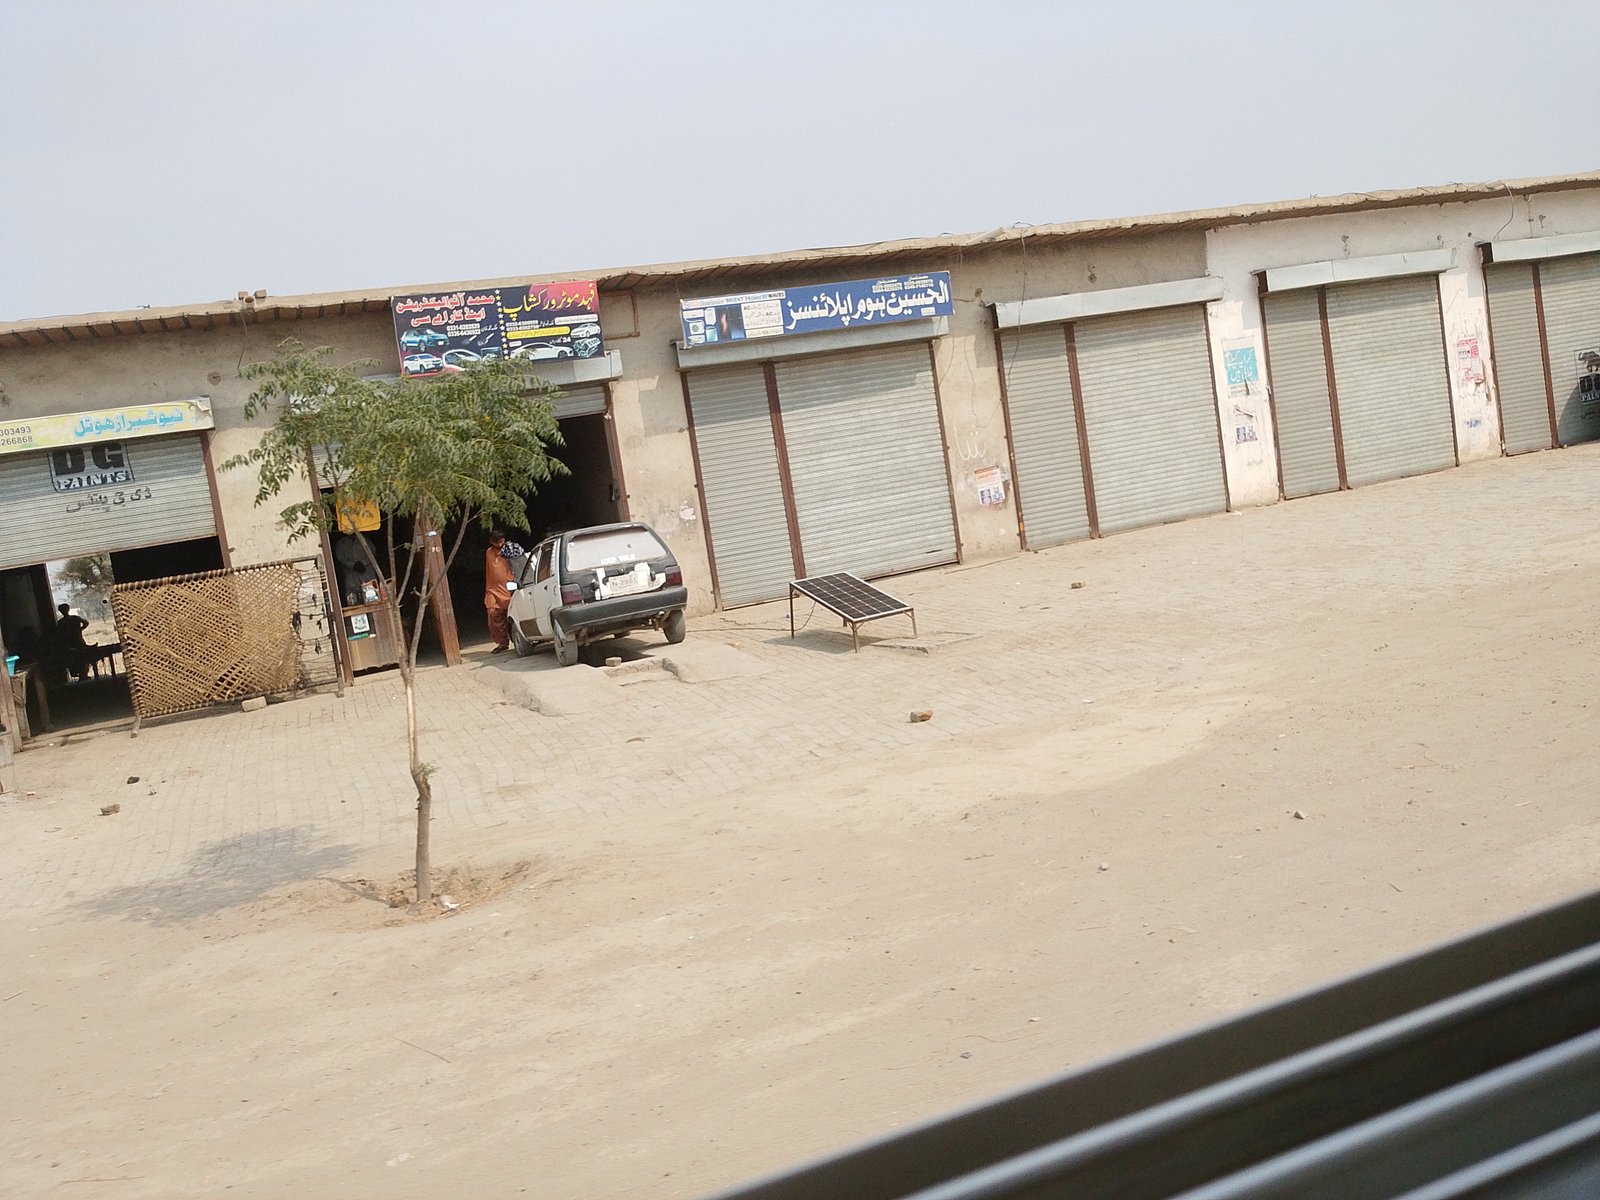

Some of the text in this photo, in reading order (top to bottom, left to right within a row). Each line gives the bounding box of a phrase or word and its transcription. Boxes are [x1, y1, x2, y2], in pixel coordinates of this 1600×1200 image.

[467, 294, 496, 306] محمد
[577, 284, 595, 310] فہد
[785, 279, 950, 330] الحسین ہوم اپلائنسز
[58, 470, 128, 490] PAINTS
